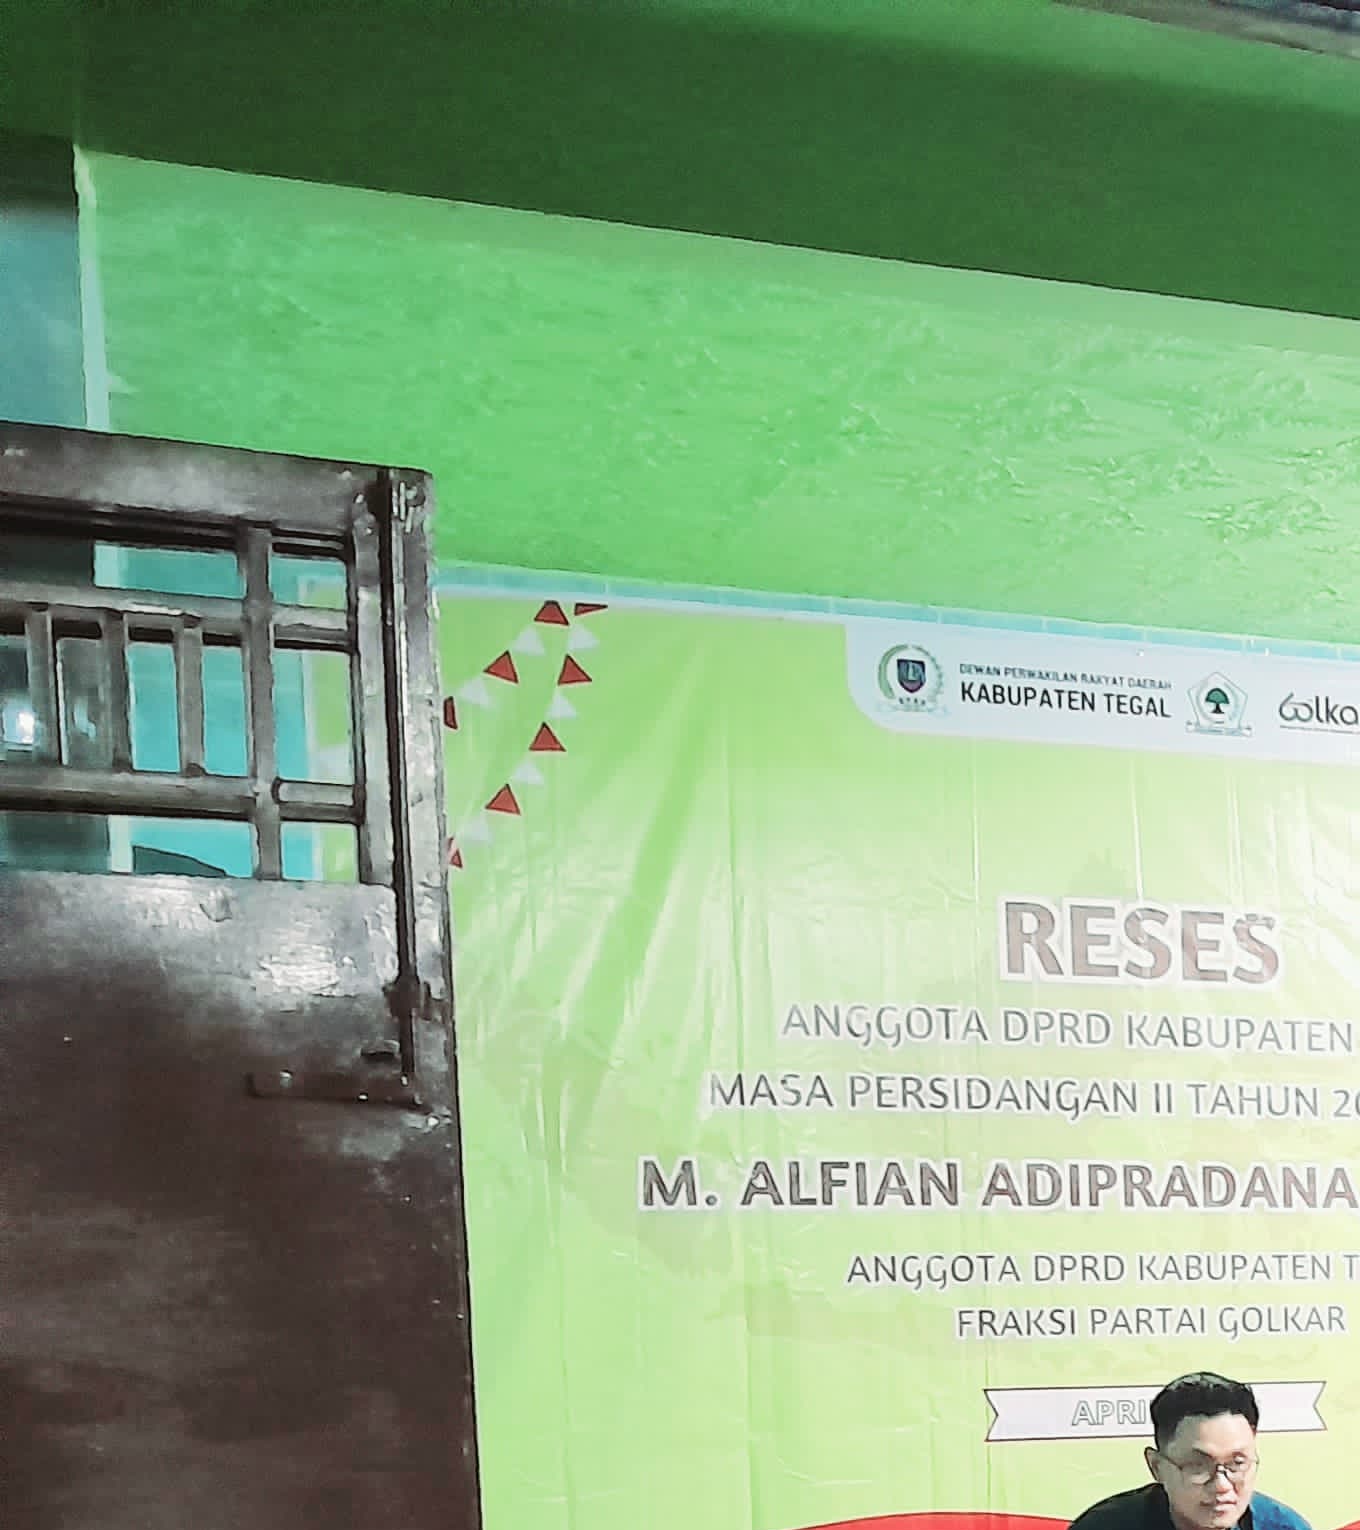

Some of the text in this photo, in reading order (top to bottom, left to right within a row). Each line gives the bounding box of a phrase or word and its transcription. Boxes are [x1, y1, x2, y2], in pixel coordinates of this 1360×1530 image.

[961, 681, 1172, 718] KABUPATEN TEGAL
[1004, 901, 1279, 983] RESES
[782, 1004, 988, 1046] ANGGOTA
[1002, 1009, 1111, 1044] DPRD
[1126, 1014, 1353, 1053] KABUPATEN
[709, 1072, 834, 1108] MASA
[848, 1074, 1140, 1119] PERSIDANGAN
[1154, 1083, 1174, 1113] II
[1188, 1083, 1319, 1116] TAHUN
[639, 1160, 720, 1206] M.
[740, 1161, 960, 1206] ALFIAN
[846, 1255, 1020, 1289] ANGGOTA
[1032, 1254, 1125, 1283] DPRD
[1138, 1252, 1332, 1282] KABUPATEN
[957, 1305, 1345, 1338] FRAKSI PARTAI GOLKAR
[1072, 1400, 1147, 1426] APRI
